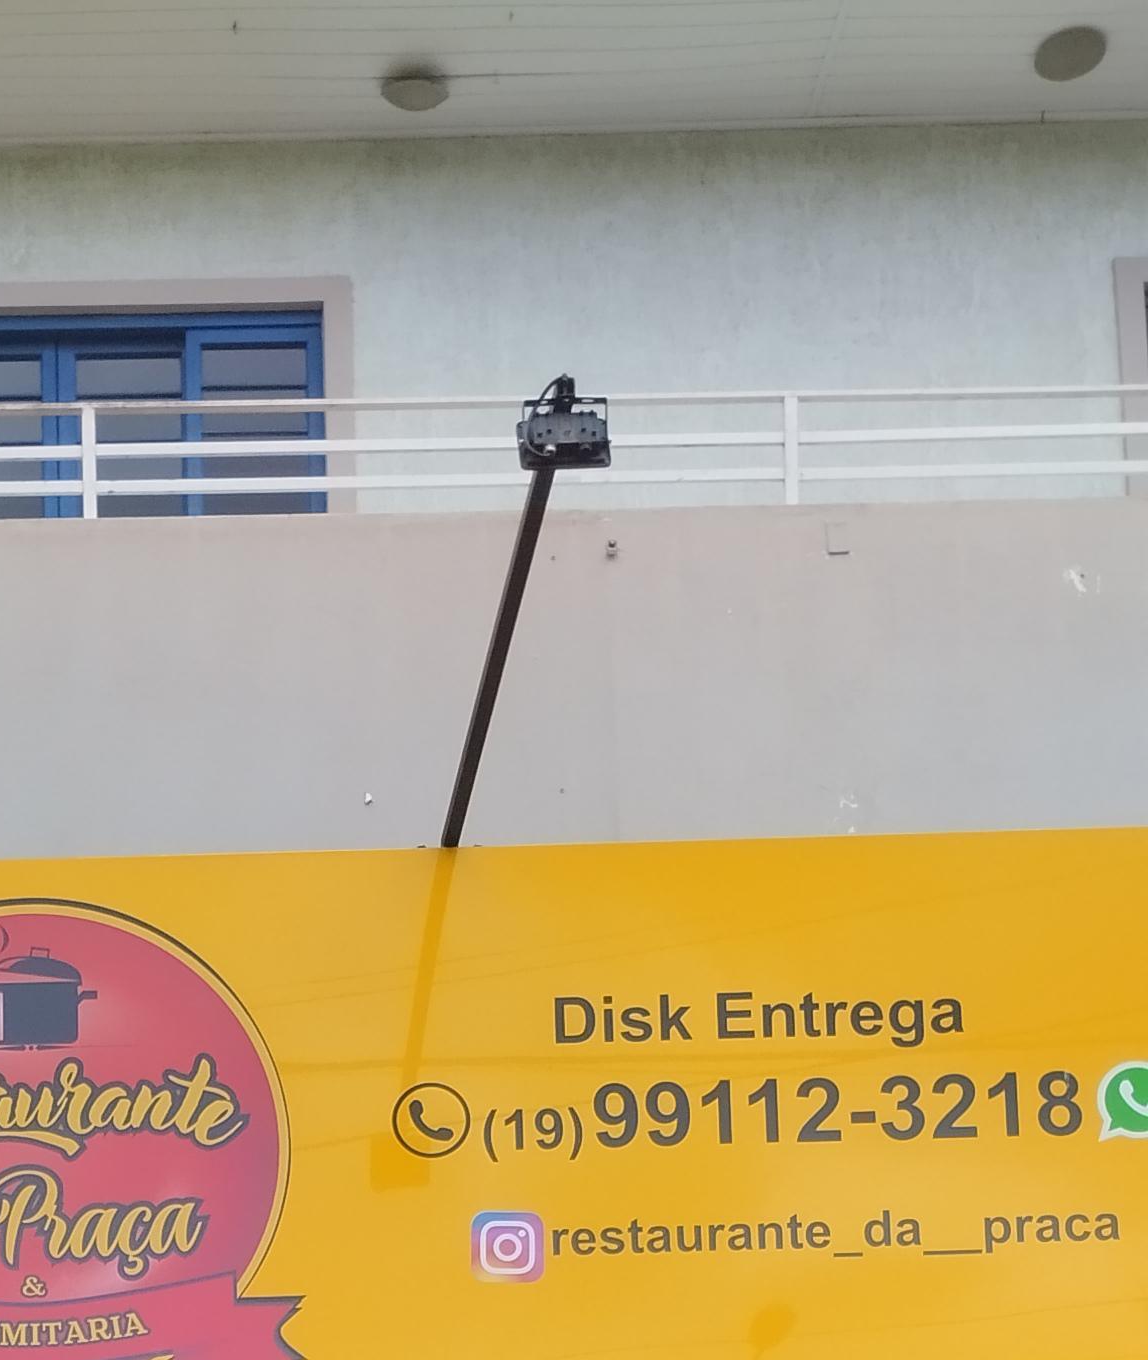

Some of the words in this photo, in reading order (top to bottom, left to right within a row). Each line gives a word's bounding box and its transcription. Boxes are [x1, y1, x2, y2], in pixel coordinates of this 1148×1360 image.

[554, 993, 693, 1044] Disk
[716, 991, 964, 1048] Entrega
[20, 1275, 48, 1298] &
